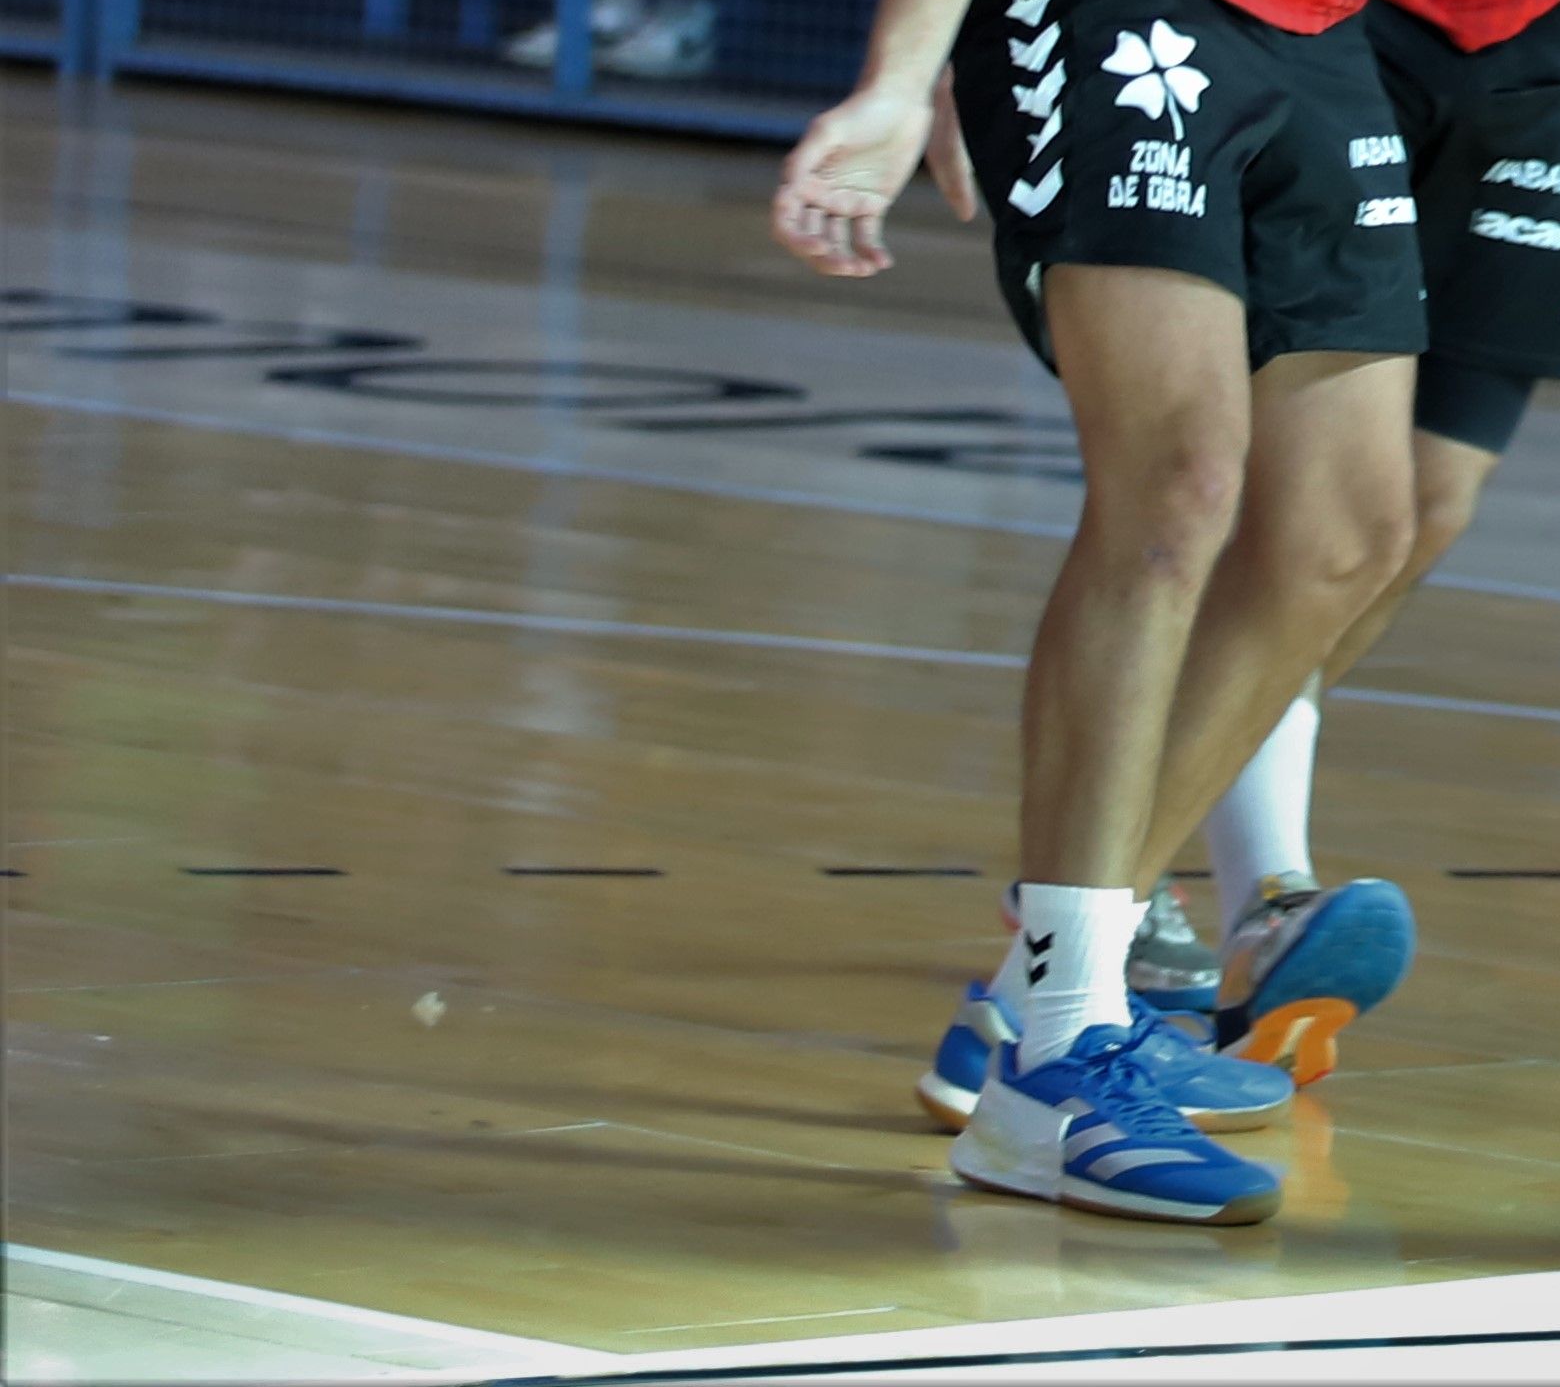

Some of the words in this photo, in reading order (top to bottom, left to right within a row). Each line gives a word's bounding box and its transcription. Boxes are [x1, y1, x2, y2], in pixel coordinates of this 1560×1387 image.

[1129, 139, 1191, 180] ZONA
[1107, 174, 1140, 208] DE
[1146, 174, 1208, 218] OBRA
